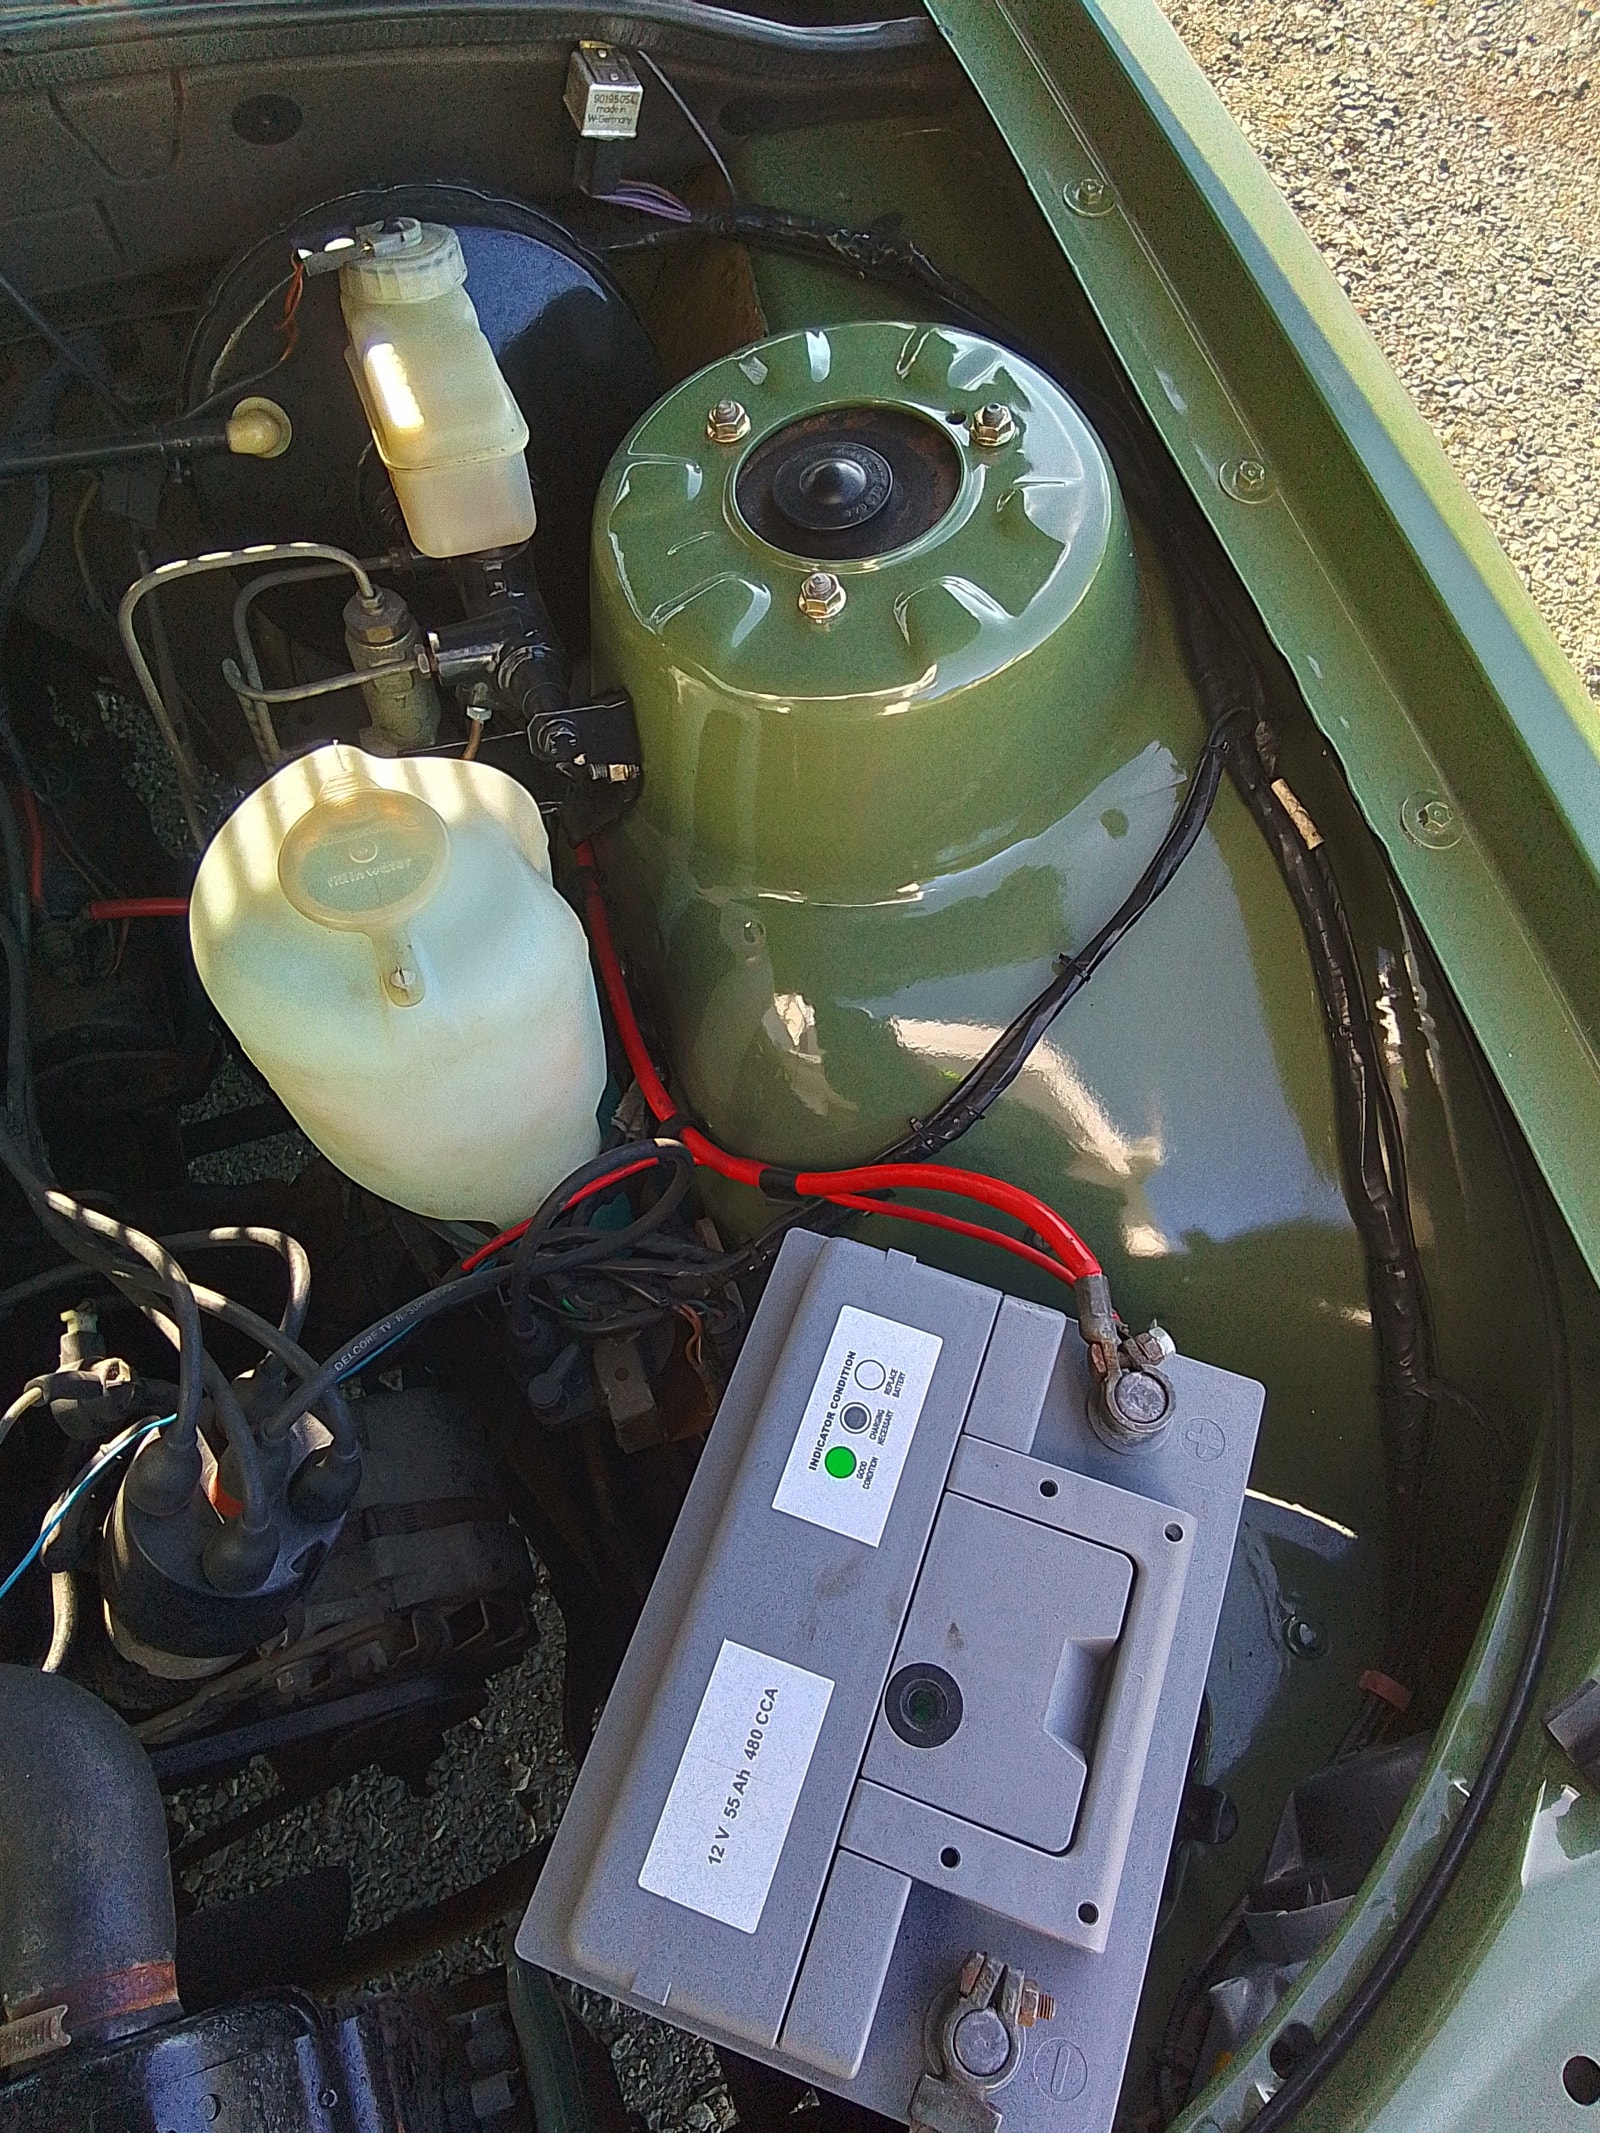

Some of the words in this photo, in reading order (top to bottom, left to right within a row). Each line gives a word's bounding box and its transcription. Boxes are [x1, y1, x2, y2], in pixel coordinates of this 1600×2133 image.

[596, 105, 618, 113] made
[333, 1332, 378, 1371] DELCORE
[379, 1322, 392, 1334] TV
[884, 1369, 898, 1395] REPLACE
[893, 1372, 906, 1398] BATTERY
[809, 1412, 836, 1471] INDICATOR
[831, 1351, 856, 1409] CONDITION
[869, 1409, 885, 1440] CHARGING
[877, 1410, 894, 1446] NECESSARY
[856, 1461, 868, 1479] GOOD
[862, 1457, 878, 1490] CONDITION
[756, 1688, 778, 1725] CCA
[744, 1729, 763, 1760] 480
[733, 1769, 751, 1795] Ah
[724, 1797, 740, 1819] 55
[715, 1826, 729, 1840] V
[708, 1845, 725, 1864] 12
